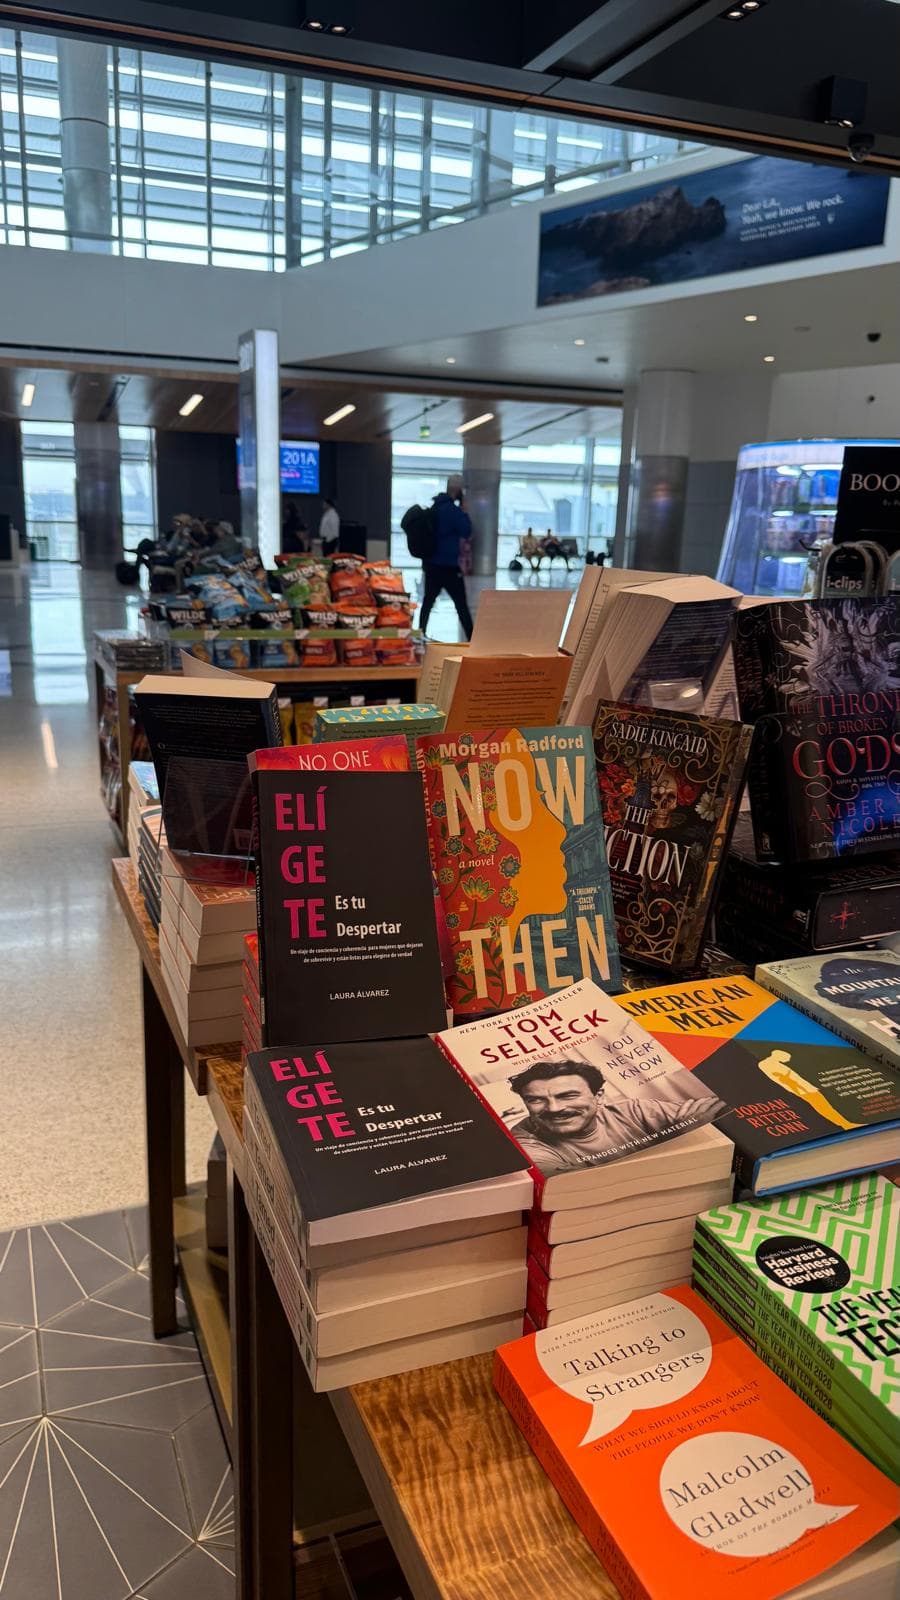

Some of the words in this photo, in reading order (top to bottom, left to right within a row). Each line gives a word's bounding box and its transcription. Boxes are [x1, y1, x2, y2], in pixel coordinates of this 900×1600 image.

[806, 200, 820, 211] We
[282, 450, 317, 466] 201A
[826, 575, 863, 591] i-clips
[169, 610, 207, 622] WILDE
[609, 722, 650, 743] SADIE
[649, 729, 708, 754] KINCAID
[816, 722, 833, 735] OF
[838, 717, 888, 734] BROKEN
[299, 754, 326, 770] NO
[333, 750, 372, 770] ONE
[438, 740, 511, 759] Morgan
[518, 735, 584, 754] Radford
[275, 785, 328, 832] ELÍ
[441, 756, 586, 836] NOW
[624, 804, 651, 825] THE
[807, 798, 886, 822] AMBER
[280, 845, 327, 884] GE
[458, 861, 467, 870] a
[468, 855, 495, 869] novel
[335, 894, 349, 910] Es
[351, 894, 366, 910] tu
[283, 898, 327, 939] TE
[336, 921, 402, 939] Despertar
[459, 914, 612, 999] THEN
[329, 990, 355, 1001] LAURA
[356, 988, 390, 999] ÁLVAREZ
[863, 996, 895, 1007] WE
[459, 1025, 477, 1034] NEW
[480, 1018, 503, 1030] YORK
[505, 1010, 530, 1022] TIMES
[532, 986, 585, 1014] BESTSELLER
[668, 1006, 744, 1032] MEN
[480, 1009, 610, 1064] SELLECK
[497, 1008, 564, 1039] TOM
[512, 1057, 531, 1066] WITH
[531, 1049, 557, 1061] ELLIS
[559, 1033, 598, 1052] HENICAN
[602, 1035, 634, 1054] YOU
[606, 1042, 655, 1069] NEVER
[269, 1051, 332, 1082] ELÍ
[618, 1054, 664, 1081] KNOW
[285, 1080, 344, 1110] GE
[357, 1106, 375, 1117] Es
[376, 1103, 396, 1114] tu
[366, 1110, 444, 1134] Despertar
[734, 1099, 790, 1119] JORDAN
[746, 1110, 801, 1129] RITTER
[296, 1111, 357, 1143] TE
[575, 1149, 618, 1163] EXPANDED
[619, 1140, 640, 1152] WITH
[642, 1132, 659, 1144] NEW
[661, 1117, 698, 1136] MATERIAL
[766, 1121, 810, 1137] CONN
[374, 1163, 407, 1175] LAURA
[407, 1153, 448, 1168] ÁLVAREZ
[765, 1248, 826, 1270] Harvard
[773, 1256, 839, 1279] Business
[782, 1267, 836, 1287] Review
[811, 1298, 869, 1327] THE
[566, 1321, 605, 1337] NATIONAL
[760, 1286, 773, 1304] THE
[772, 1298, 790, 1322] YEAR
[799, 1326, 816, 1348] TECH
[817, 1344, 835, 1371] 2026
[563, 1335, 661, 1376] Talking
[660, 1327, 686, 1342] to
[757, 1305, 770, 1324] THE
[771, 1319, 788, 1341] YEAR
[796, 1345, 814, 1369] TECH
[814, 1365, 833, 1389] 2026
[585, 1351, 705, 1402] Strangers
[757, 1325, 769, 1343] THE
[771, 1336, 787, 1361] YEAR
[796, 1365, 814, 1389] TECH
[814, 1385, 833, 1410] 2026
[593, 1434, 627, 1454] WHAT
[628, 1425, 648, 1438] WE
[649, 1409, 691, 1431] SHOULD
[692, 1395, 723, 1415] KNOW
[725, 1379, 760, 1402] ABOUT
[610, 1447, 634, 1462] THE
[635, 1429, 678, 1451] PEOPLE
[678, 1420, 699, 1435] WE
[699, 1408, 729, 1428] DON'T
[731, 1393, 762, 1414] KNOW
[665, 1449, 785, 1509] Malcolm
[690, 1469, 812, 1538] Gladwell
[752, 1523, 768, 1533] THE
